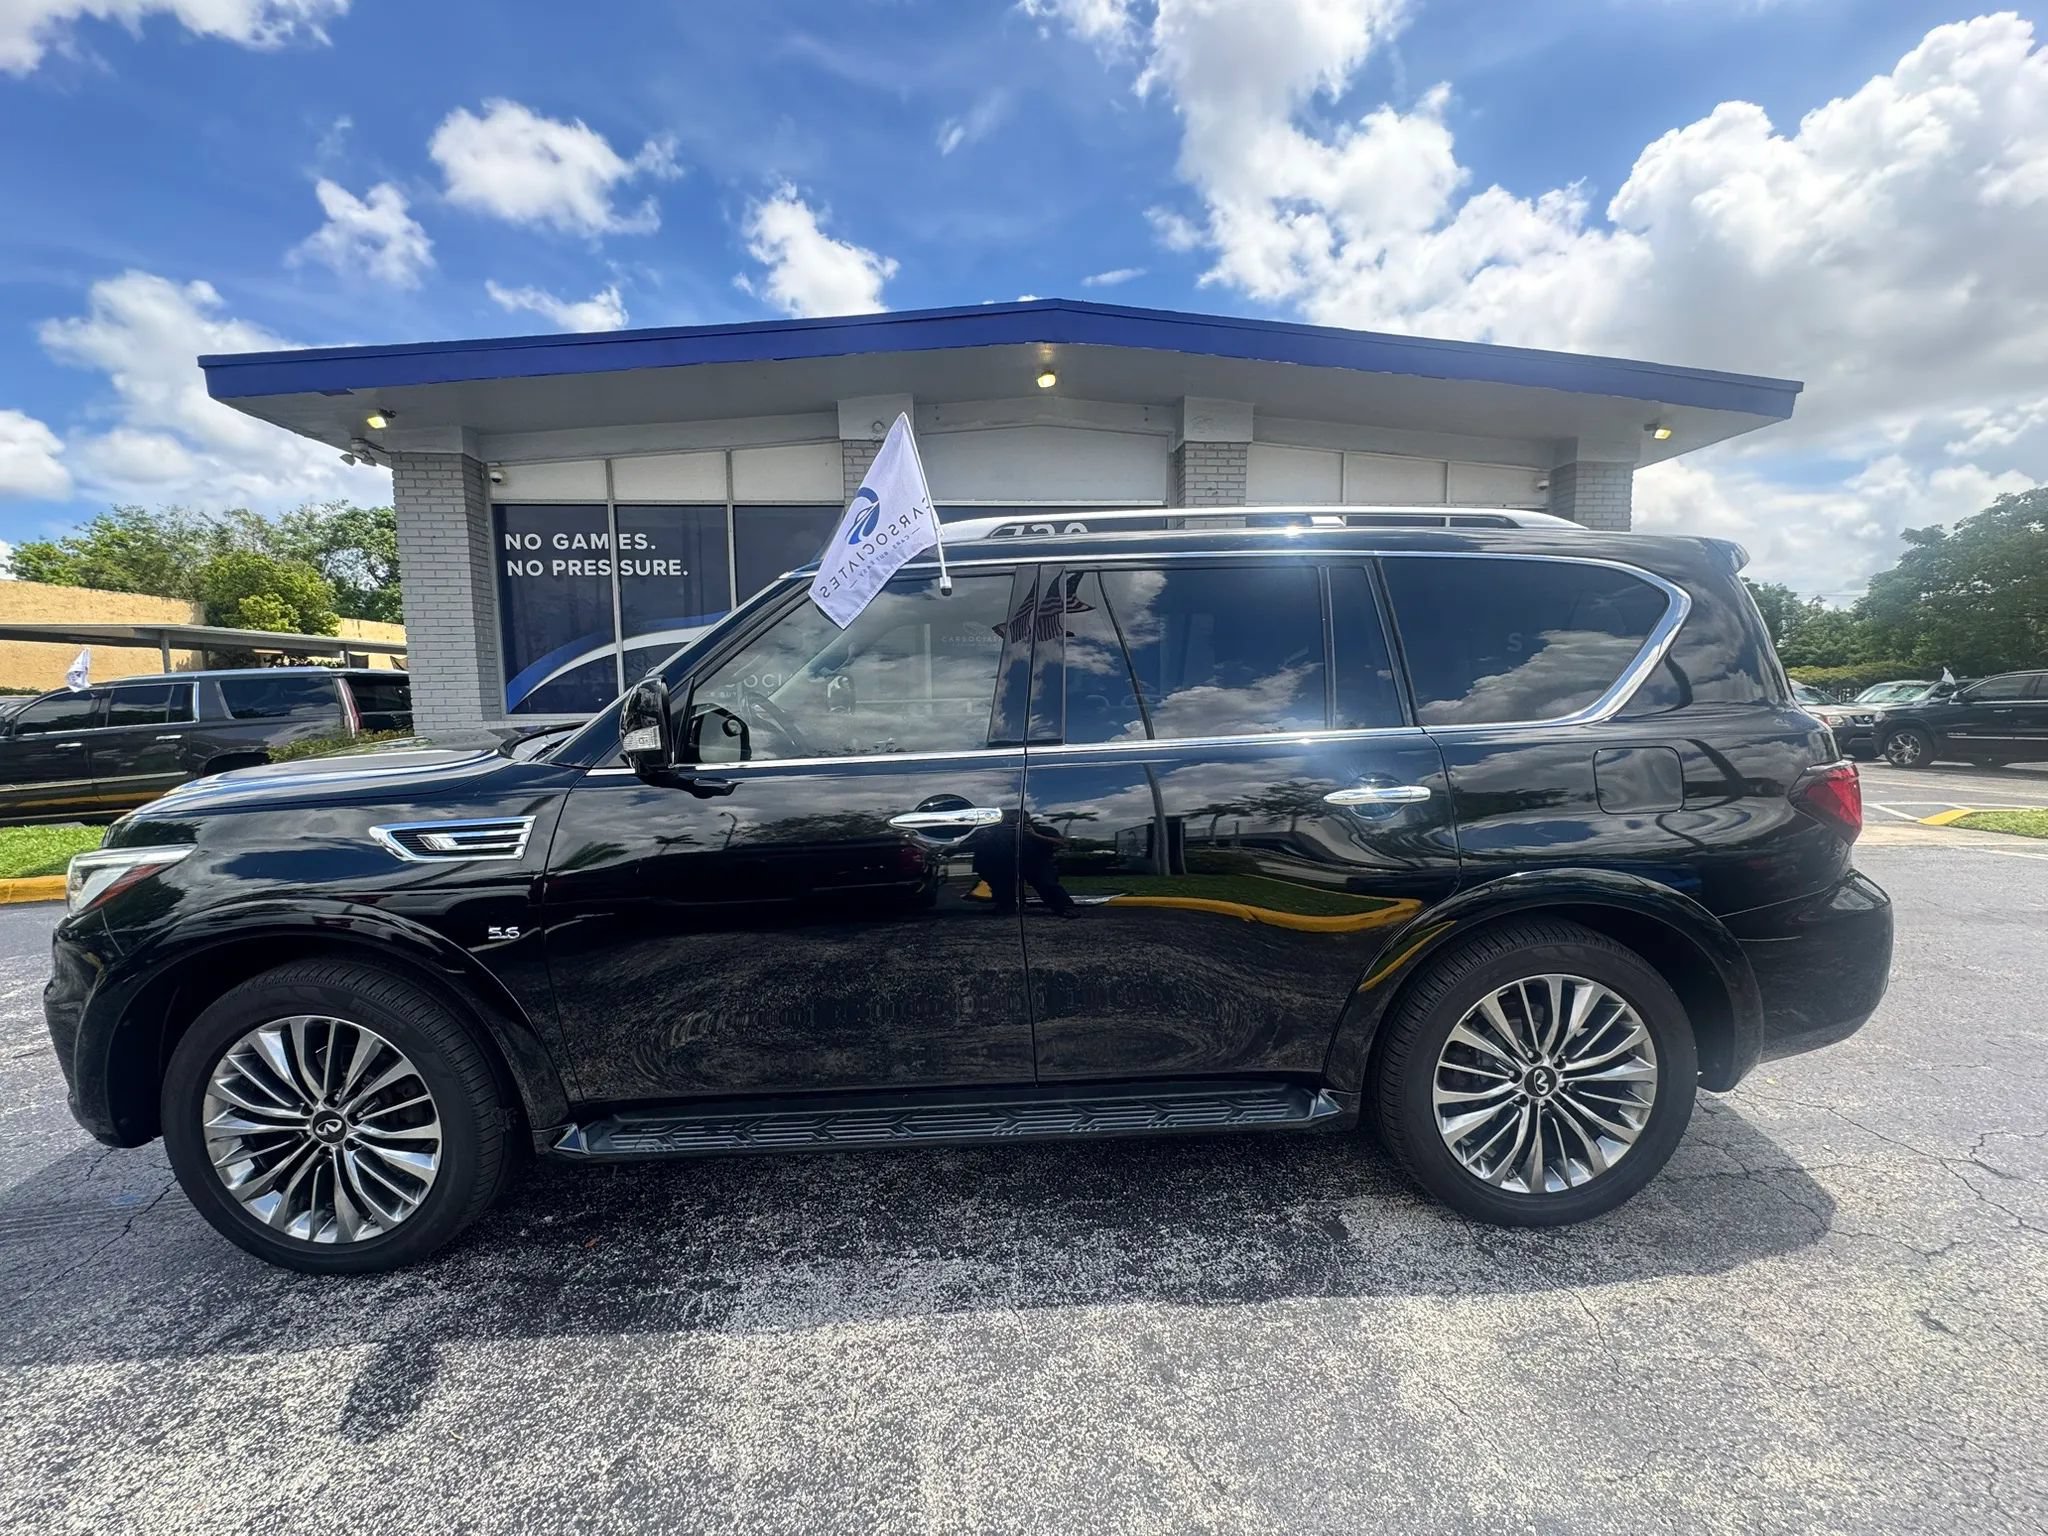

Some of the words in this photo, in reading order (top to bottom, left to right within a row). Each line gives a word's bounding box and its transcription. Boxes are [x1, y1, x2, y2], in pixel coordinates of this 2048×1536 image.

[505, 533, 542, 550] NO
[552, 533, 656, 550] GAMES.
[507, 560, 544, 576] NO
[552, 560, 689, 576] PRESSURE.
